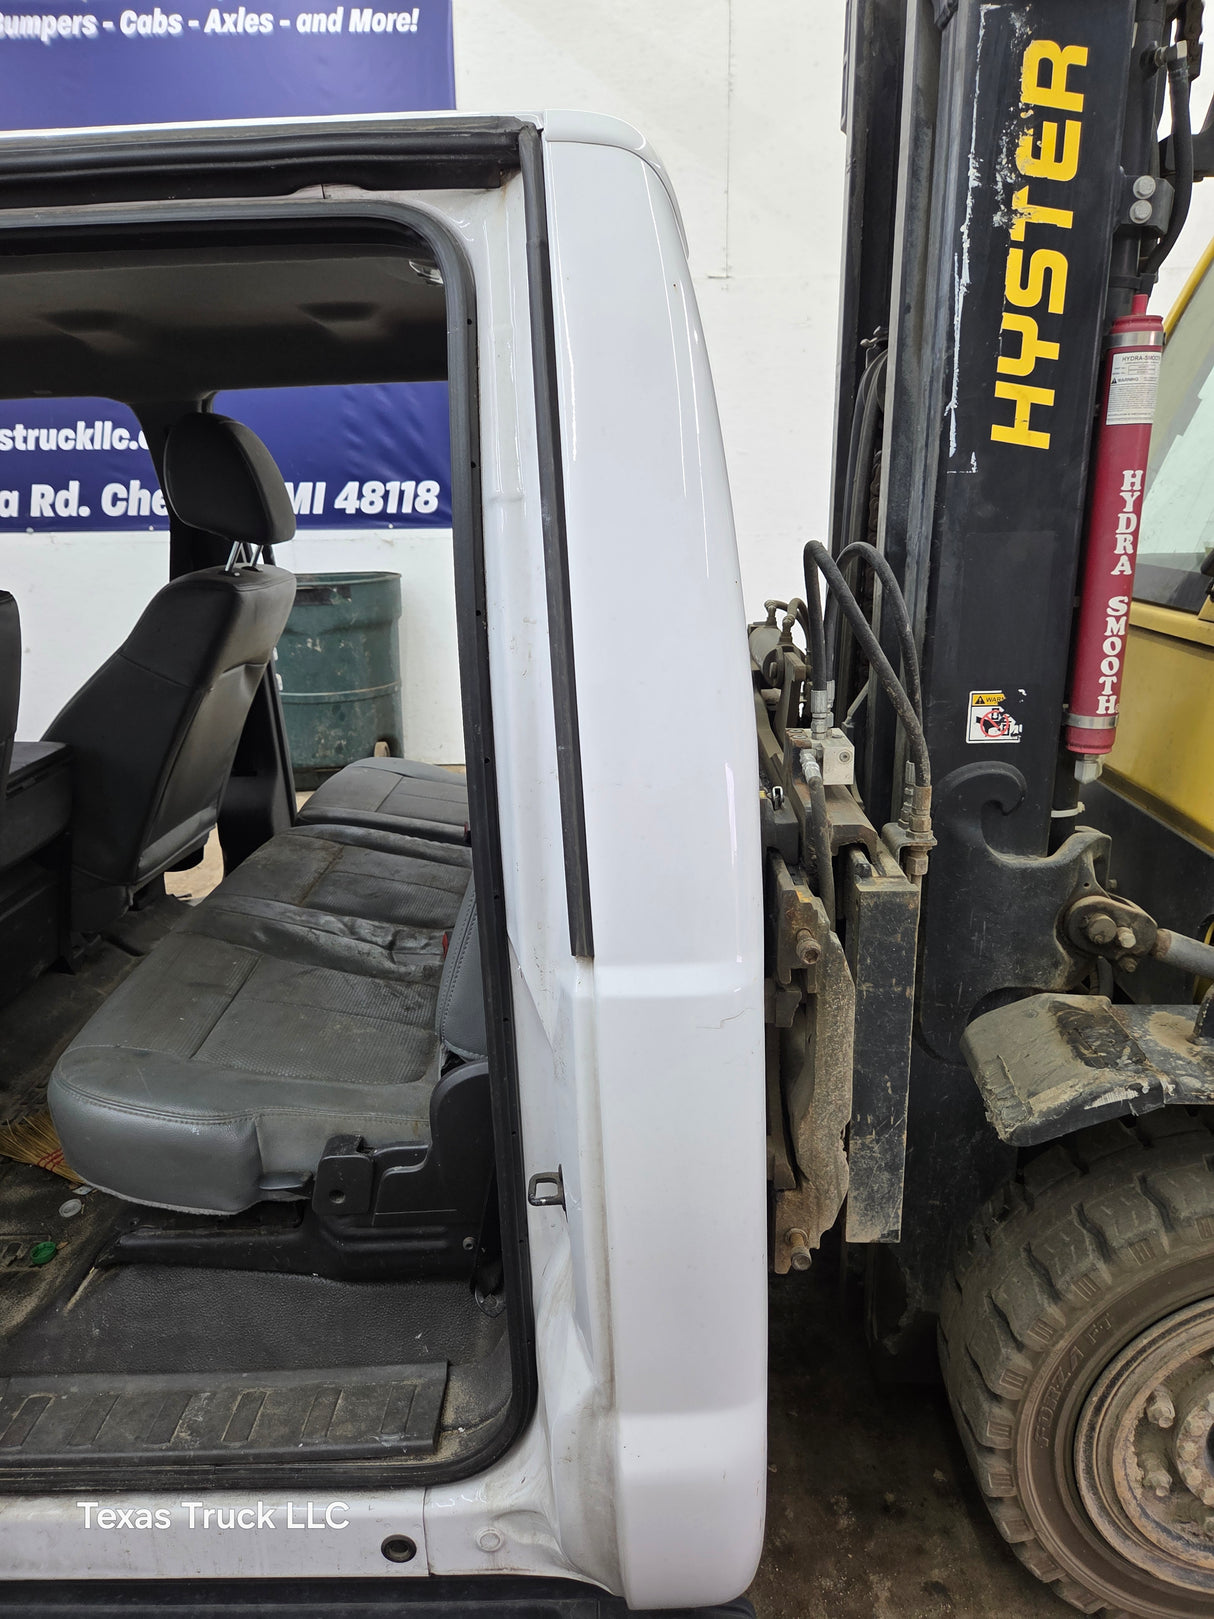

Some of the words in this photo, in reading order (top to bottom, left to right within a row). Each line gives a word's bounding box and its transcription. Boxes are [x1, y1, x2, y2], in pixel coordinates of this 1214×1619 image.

[120, 8, 183, 35] Cabs
[204, 7, 273, 33] Axles
[297, 7, 343, 33] and
[348, 8, 419, 33] More!
[990, 39, 1089, 450] HYSTER
[30, 480, 90, 518] Rd.
[284, 481, 326, 515] MI
[334, 480, 440, 515] 48118
[1110, 469, 1144, 576] HYDRA
[1096, 596, 1129, 715] SMOOTH
